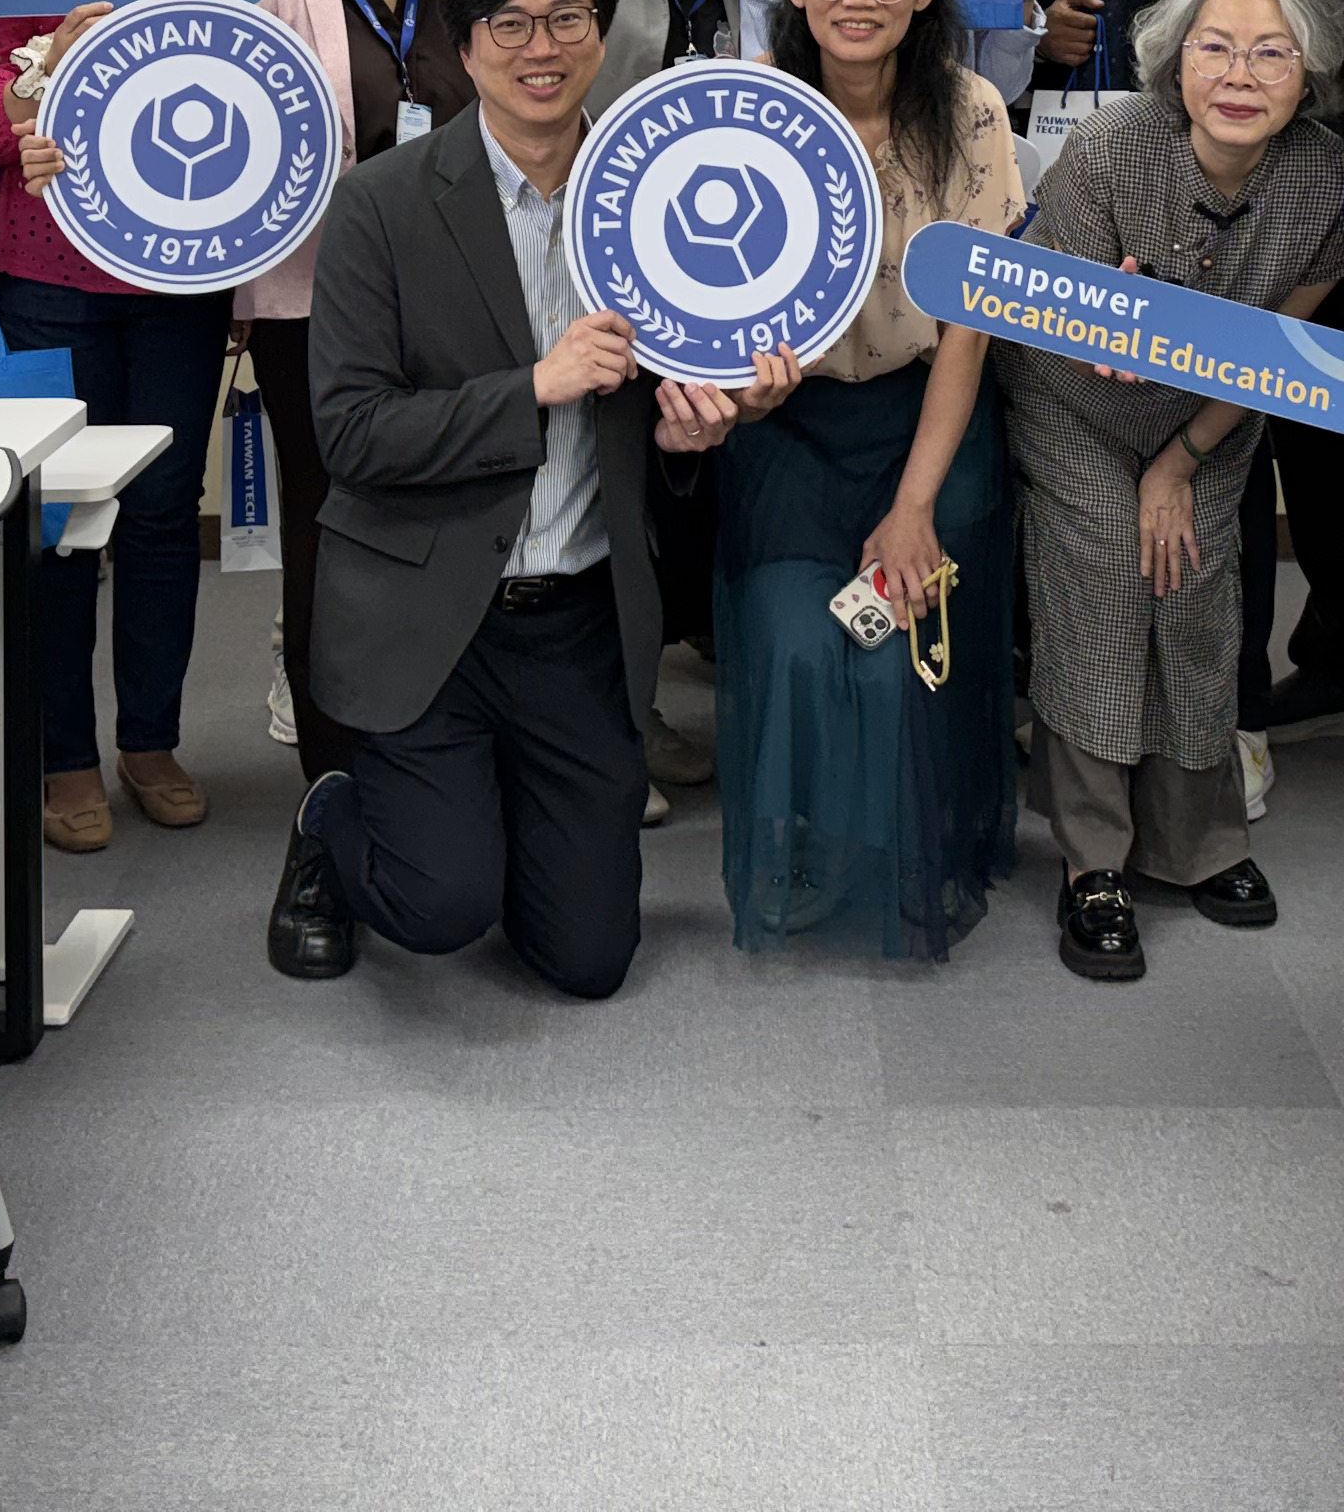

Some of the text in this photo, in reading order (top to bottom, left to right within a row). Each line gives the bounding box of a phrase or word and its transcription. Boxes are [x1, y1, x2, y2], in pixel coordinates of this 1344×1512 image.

[73, 19, 312, 116] TAIWAN TECH
[1035, 124, 1063, 135] TECH
[1037, 115, 1079, 126] TAIWAN
[592, 89, 818, 238] TAIWAN TECH
[142, 232, 228, 266] 1974
[967, 244, 1151, 321] Empower
[730, 297, 817, 357] 1974
[962, 281, 1331, 412] Vocational Education
[244, 418, 255, 523] TAIWAN TECH
